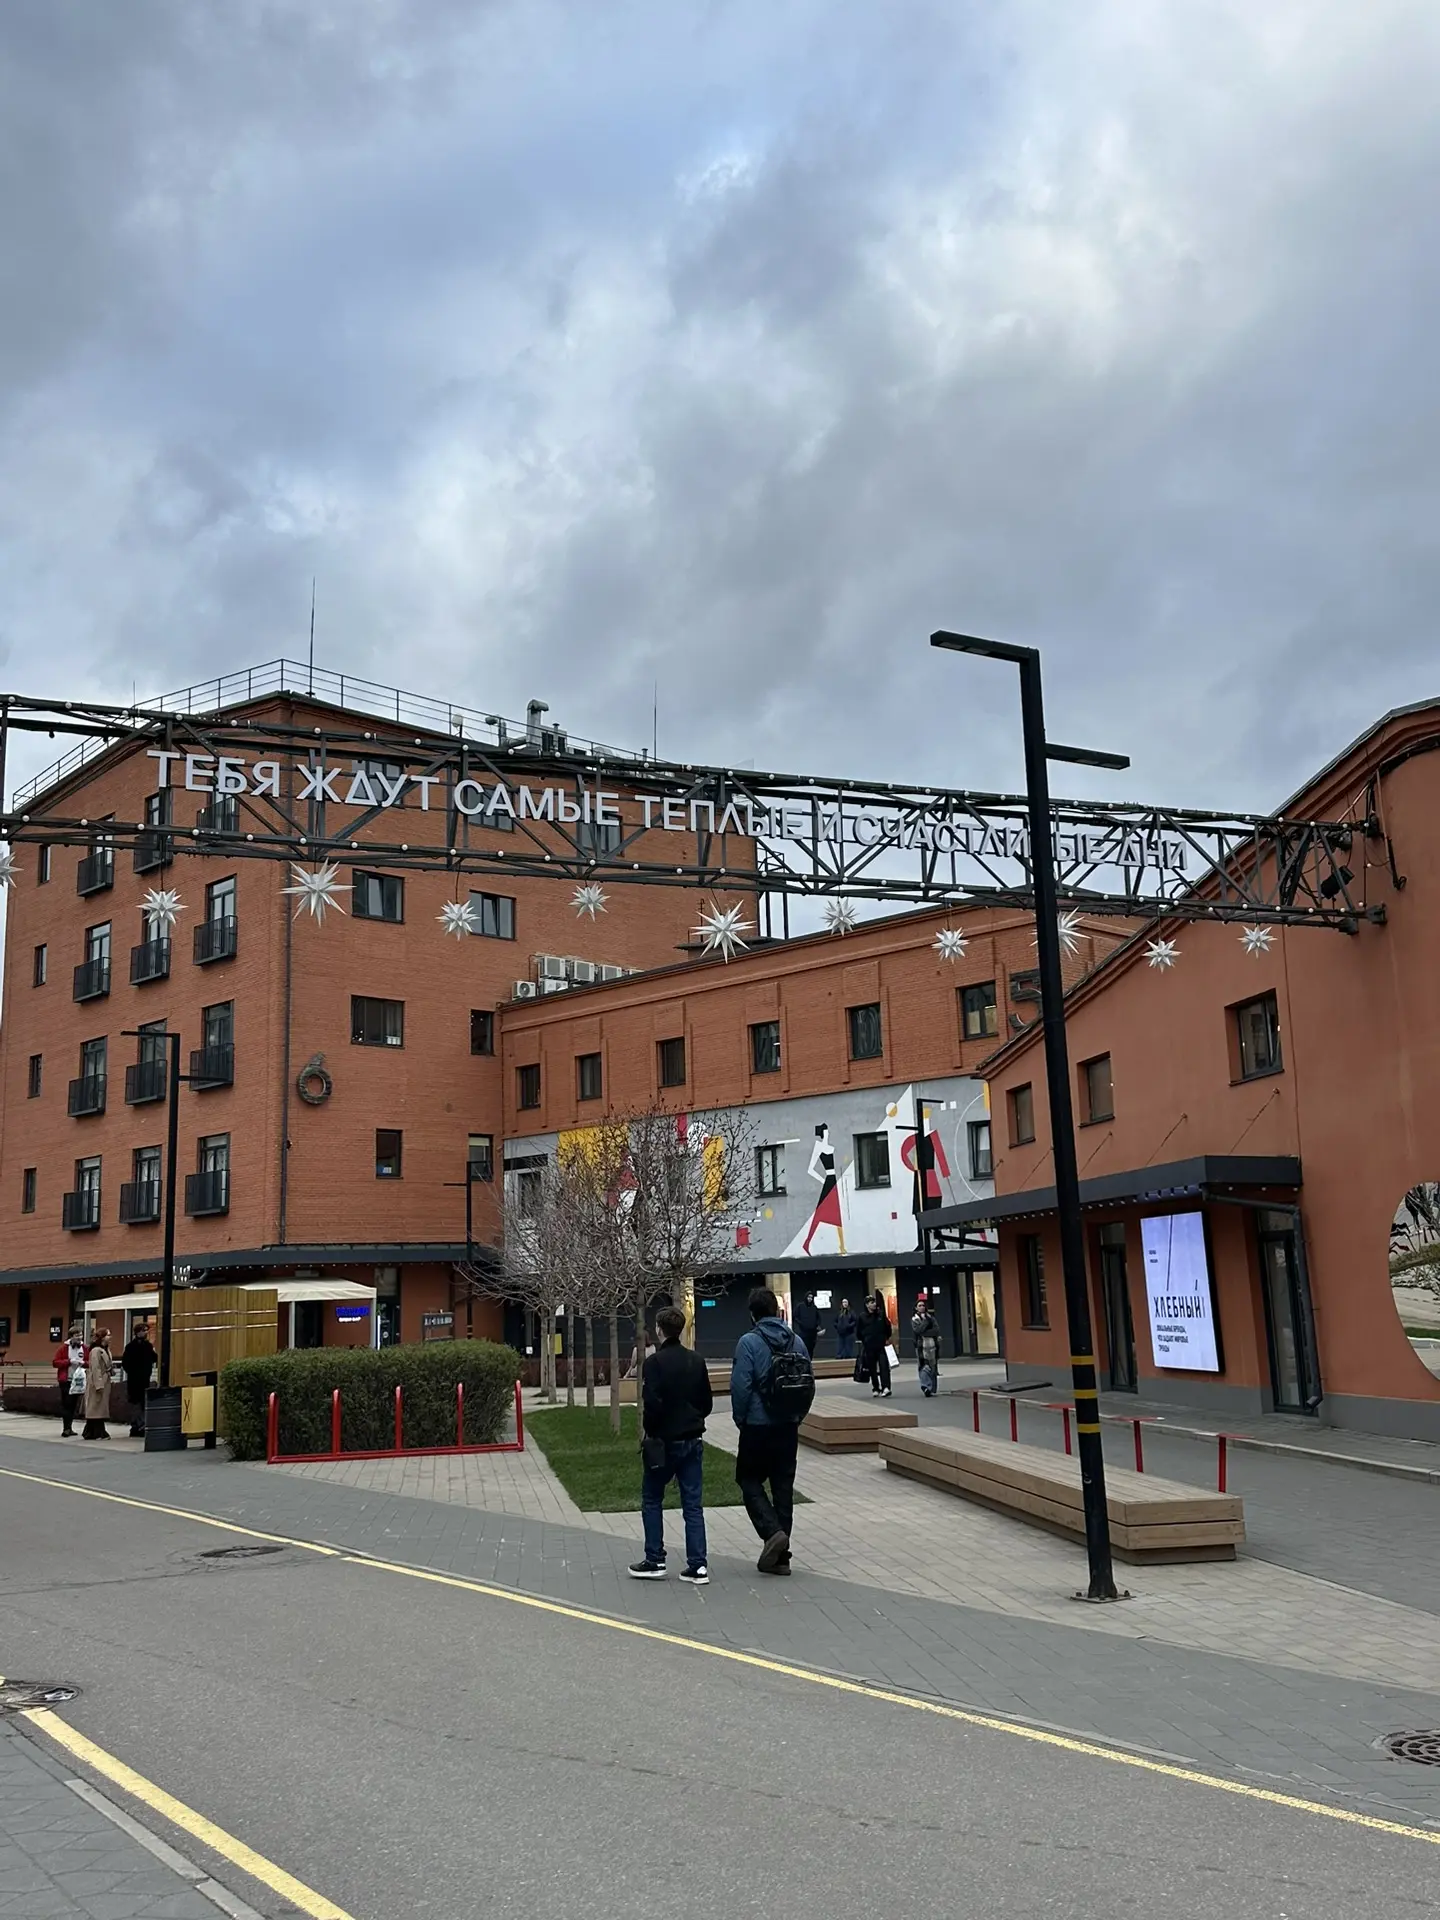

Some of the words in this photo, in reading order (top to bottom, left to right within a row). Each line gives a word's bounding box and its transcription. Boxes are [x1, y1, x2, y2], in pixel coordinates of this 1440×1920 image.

[146, 749, 281, 799] ТЕБЯ
[296, 763, 440, 812] ЖДУТ
[453, 778, 621, 827] САМЫЕ
[634, 794, 804, 841] ТЕПЛЫЕ
[816, 810, 843, 843] И
[852, 813, 1107, 865] СЧАСТЛИЫЕ
[1117, 836, 1188, 870] ДНИ
[1153, 1294, 1202, 1319] ХЛЕБНЫЙ
